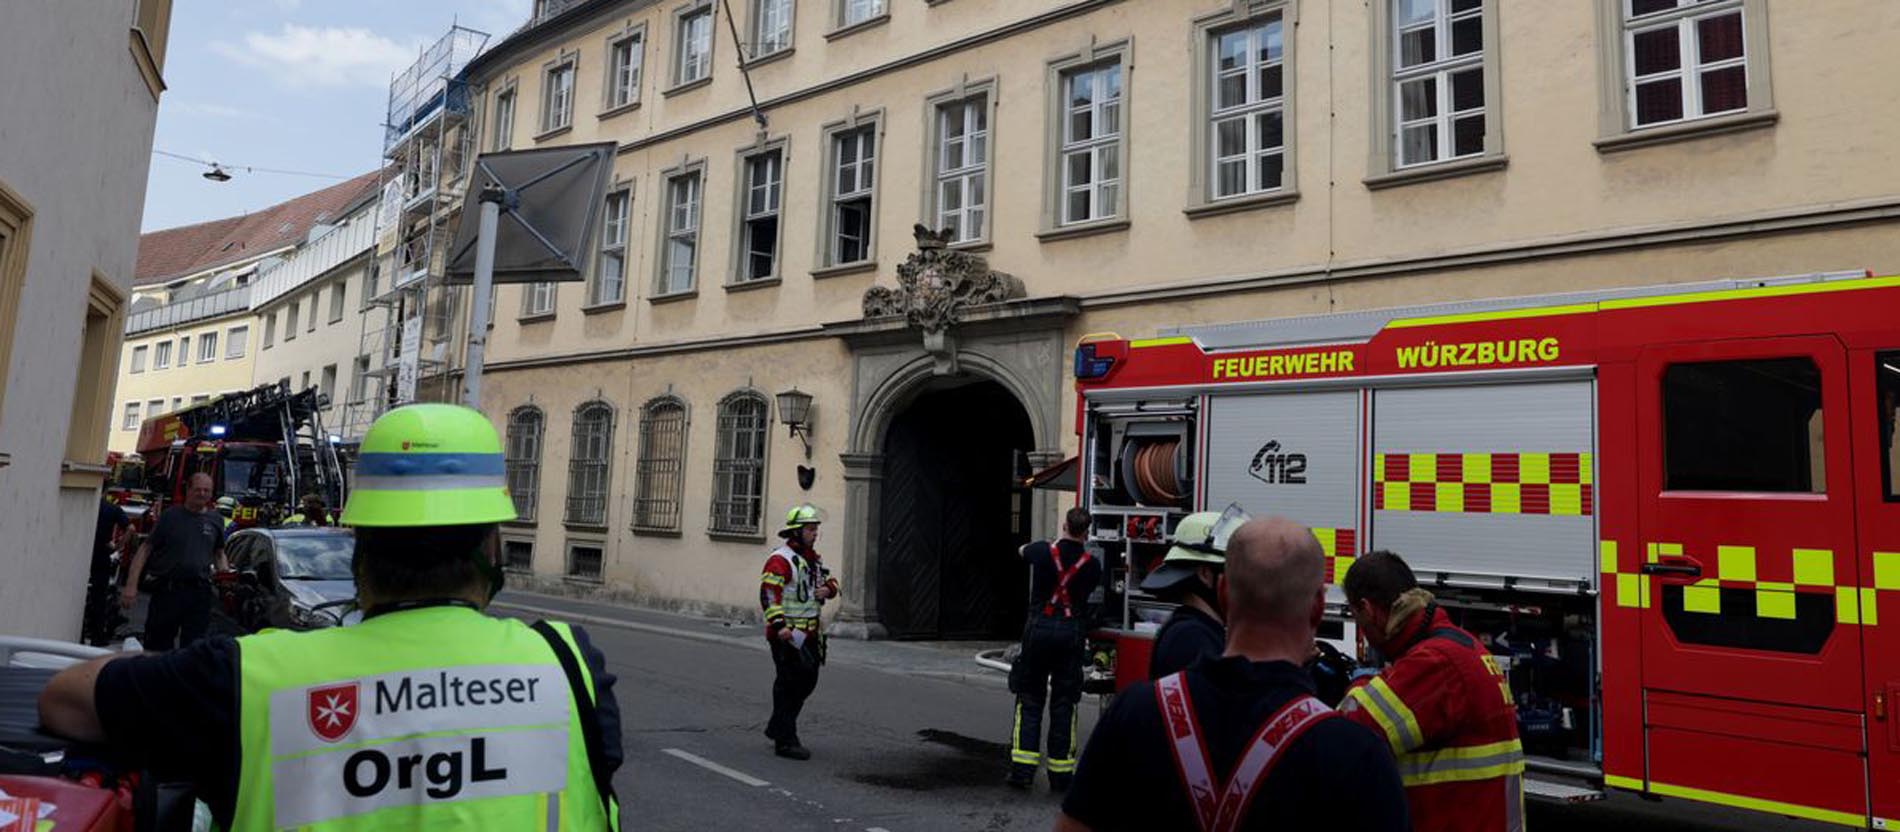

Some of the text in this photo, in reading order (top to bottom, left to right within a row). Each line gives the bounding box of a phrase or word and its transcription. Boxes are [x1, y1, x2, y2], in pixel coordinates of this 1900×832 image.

[1212, 337, 1559, 379] FEUERWEHR WÜRZBURG
[1265, 453, 1307, 485] 112
[375, 672, 539, 715] Malteser
[343, 737, 507, 799] OrgL
